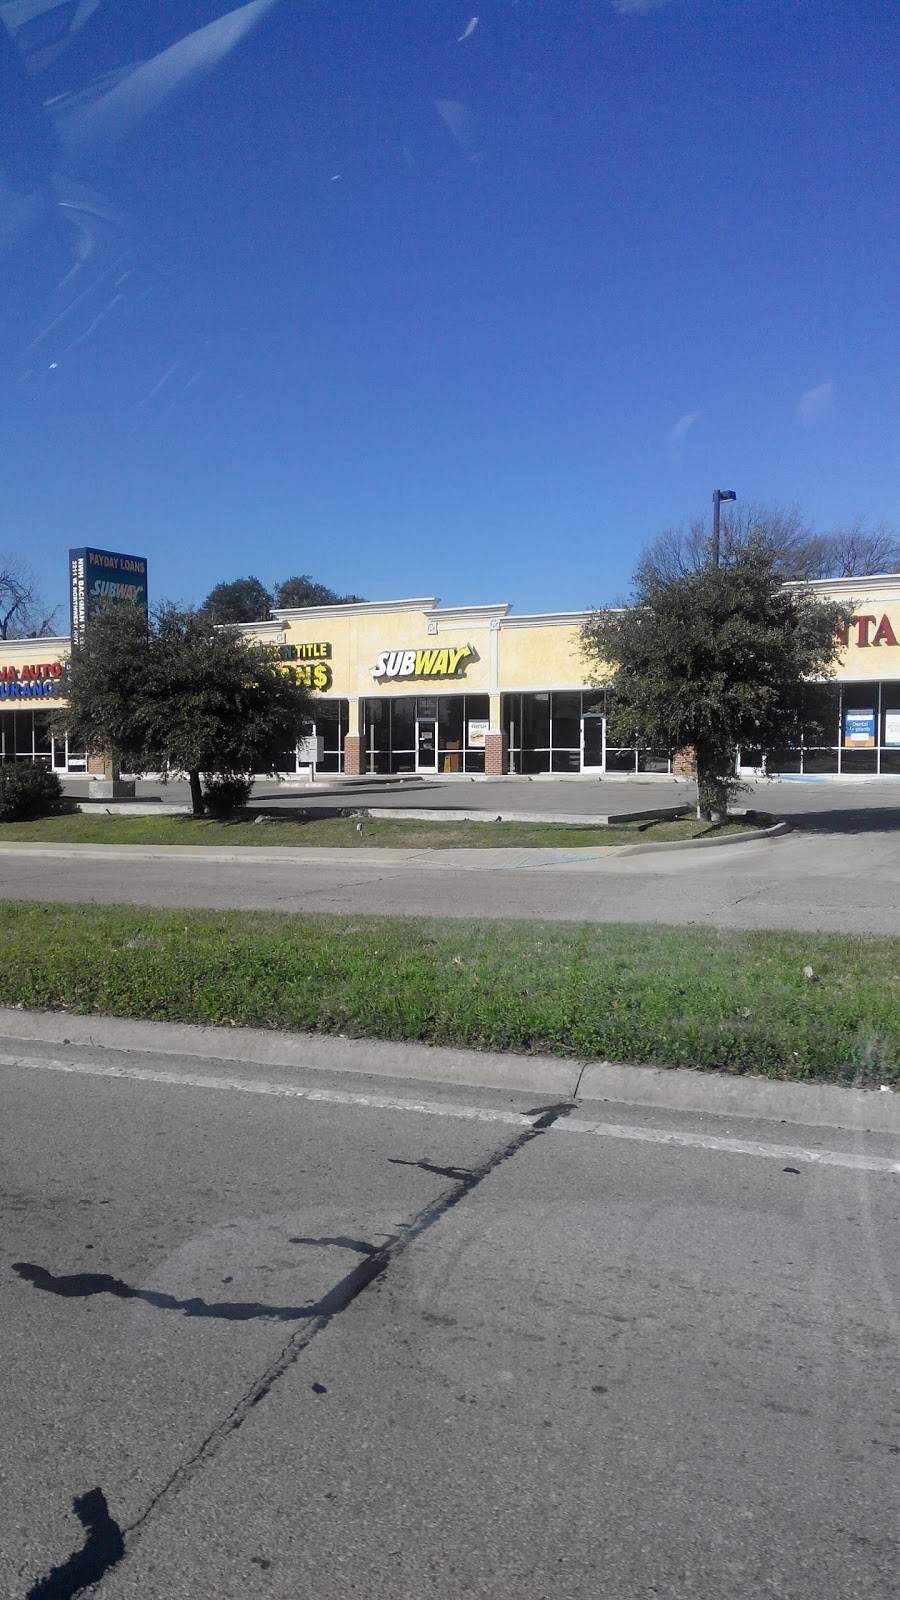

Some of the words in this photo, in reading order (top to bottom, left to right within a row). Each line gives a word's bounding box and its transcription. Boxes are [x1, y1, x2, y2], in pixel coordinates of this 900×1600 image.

[89, 553, 118, 569] PAYDAY
[90, 580, 144, 600] SUBWAY
[369, 647, 471, 676] SUBWAY
[21, 662, 62, 680] AUTO
[0, 681, 60, 697] URANC
